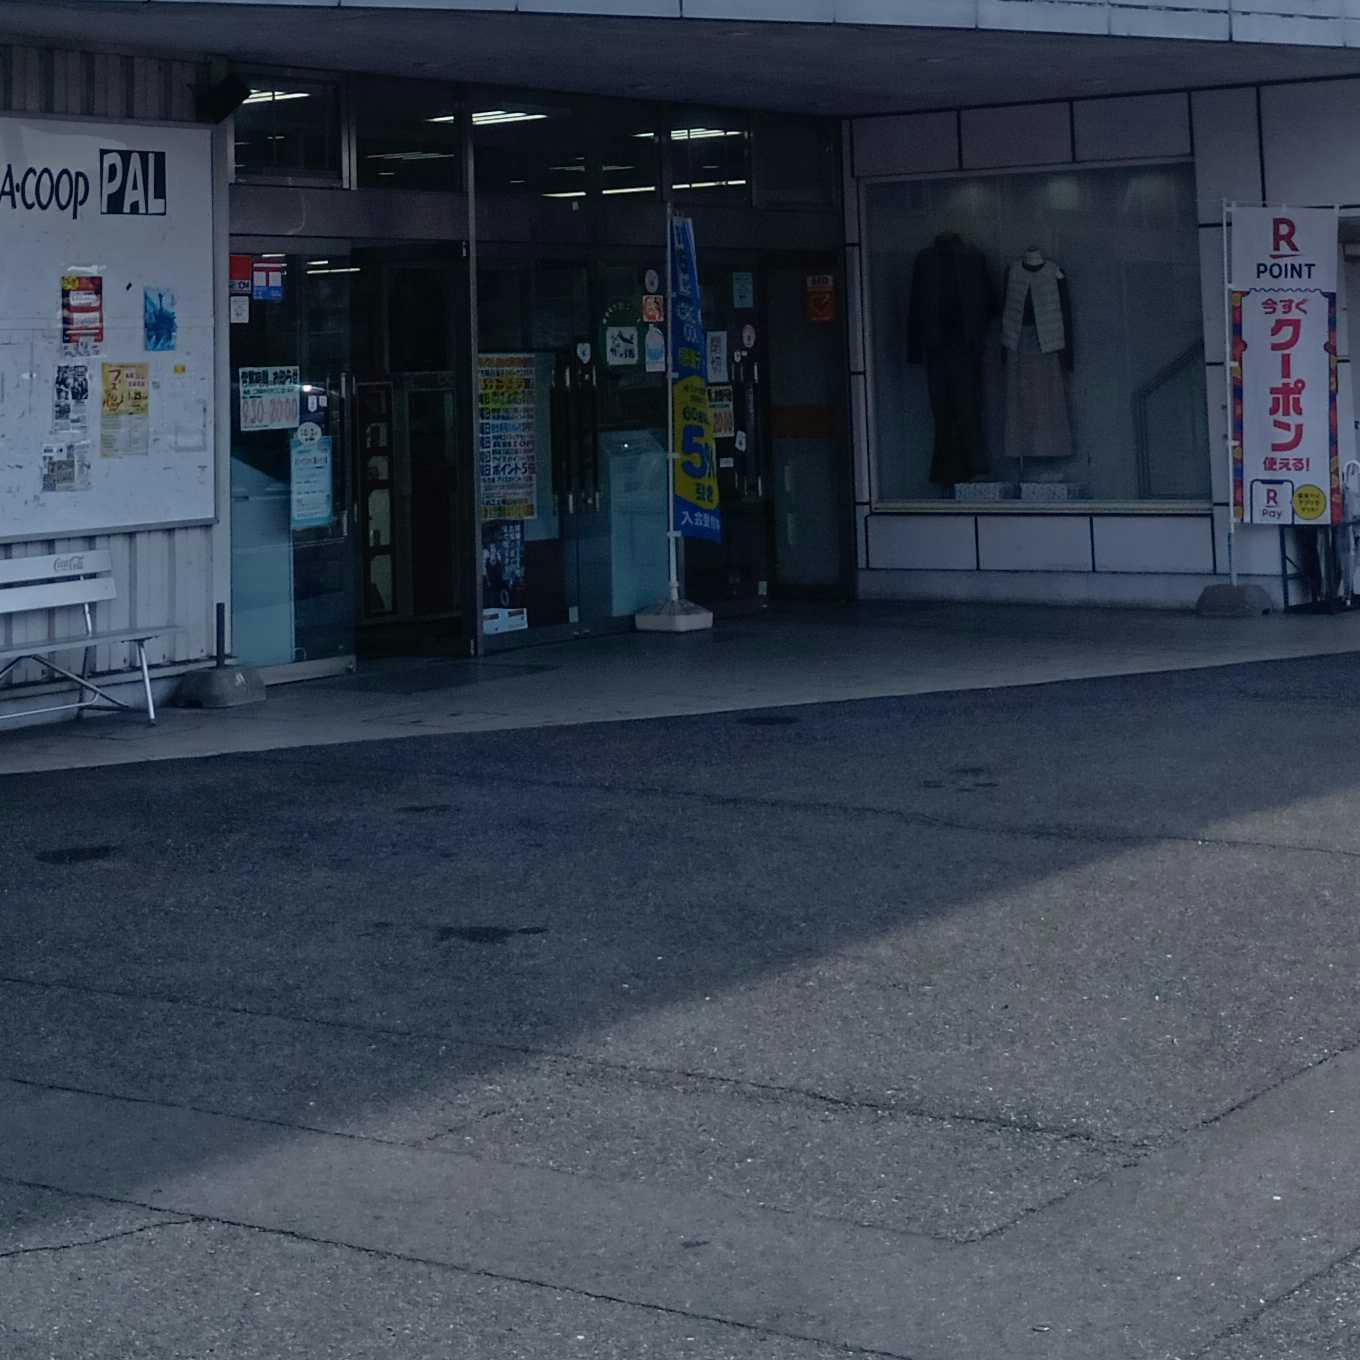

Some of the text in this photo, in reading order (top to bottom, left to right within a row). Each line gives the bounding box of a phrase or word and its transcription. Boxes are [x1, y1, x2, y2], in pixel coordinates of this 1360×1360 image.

[101, 150, 166, 214] PAL
[1272, 217, 1300, 253] R
[1256, 262, 1317, 281] POINT
[1261, 297, 1309, 316] 今すぐ
[1269, 318, 1307, 452] クーポン
[1262, 508, 1281, 519] Pay
